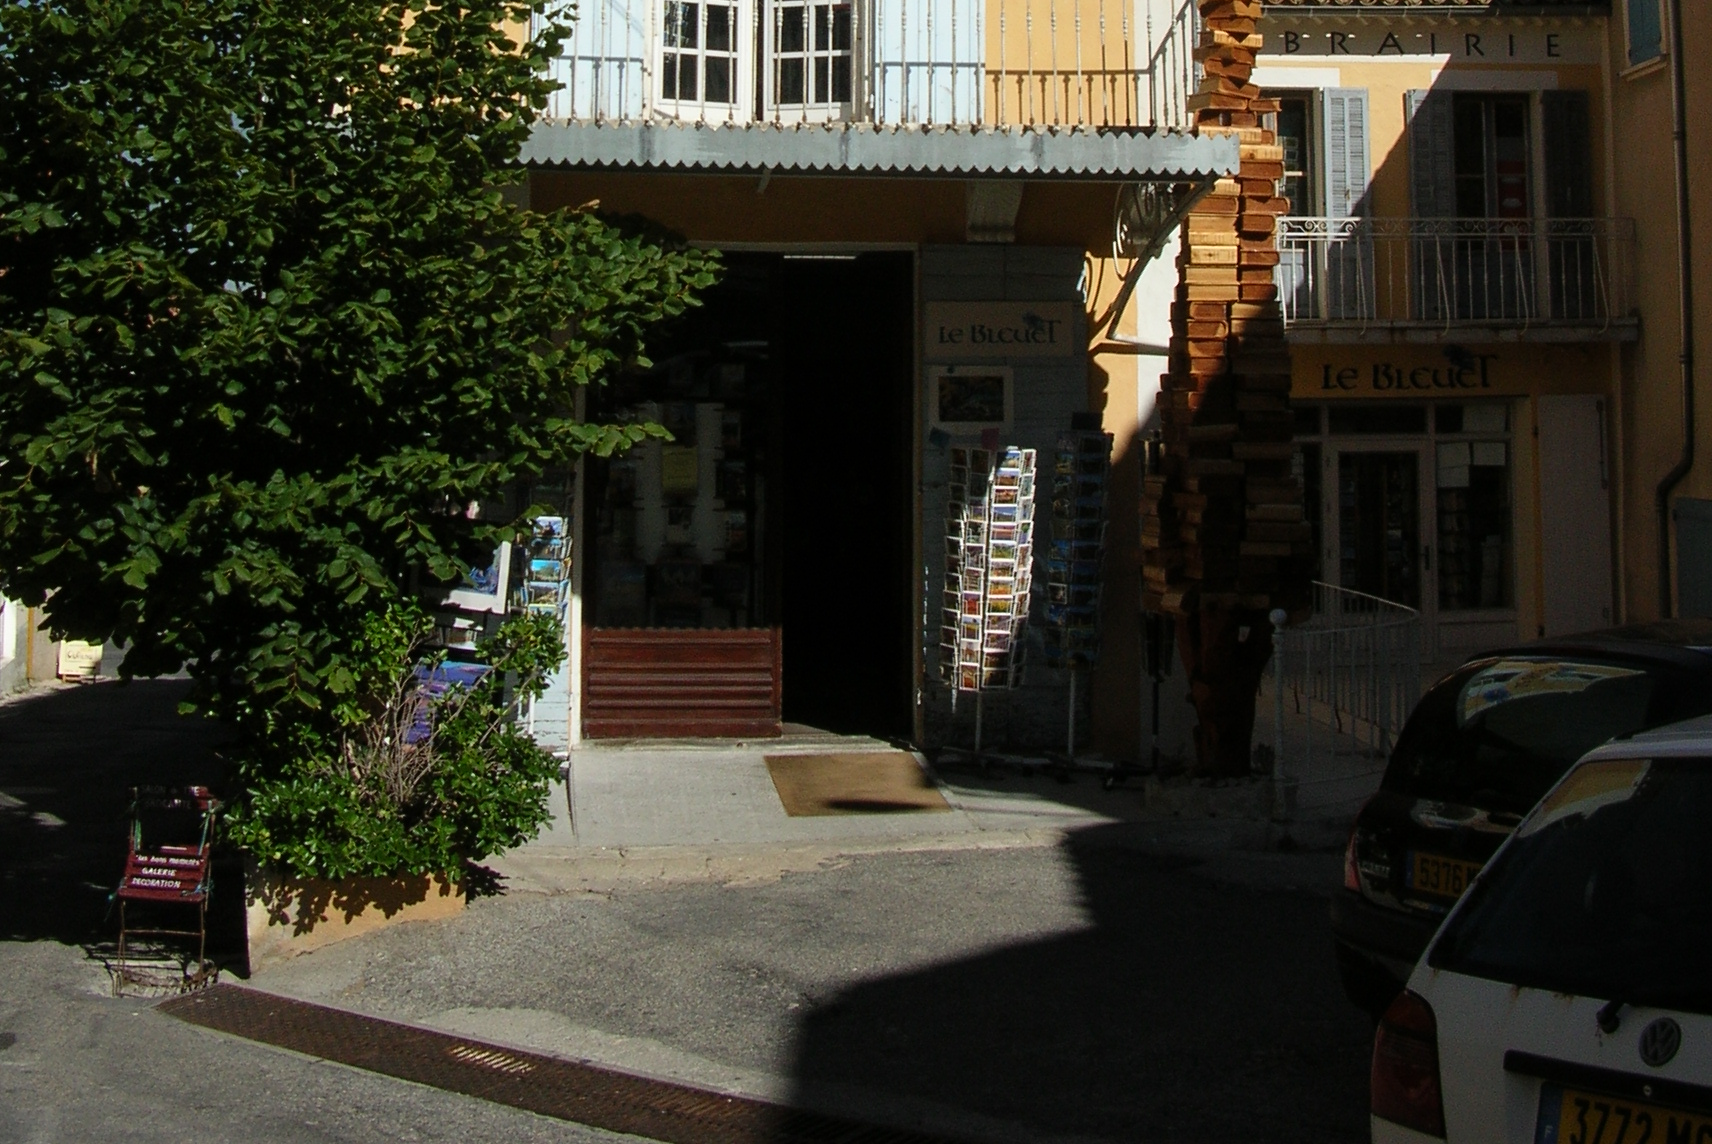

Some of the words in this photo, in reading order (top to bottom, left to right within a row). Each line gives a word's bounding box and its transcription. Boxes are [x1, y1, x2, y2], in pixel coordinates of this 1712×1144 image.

[1284, 30, 1561, 58] BRAIRIE
[141, 867, 177, 877] GALERIE
[1420, 857, 1463, 894] 5376
[1570, 1096, 1653, 1144] 3772
